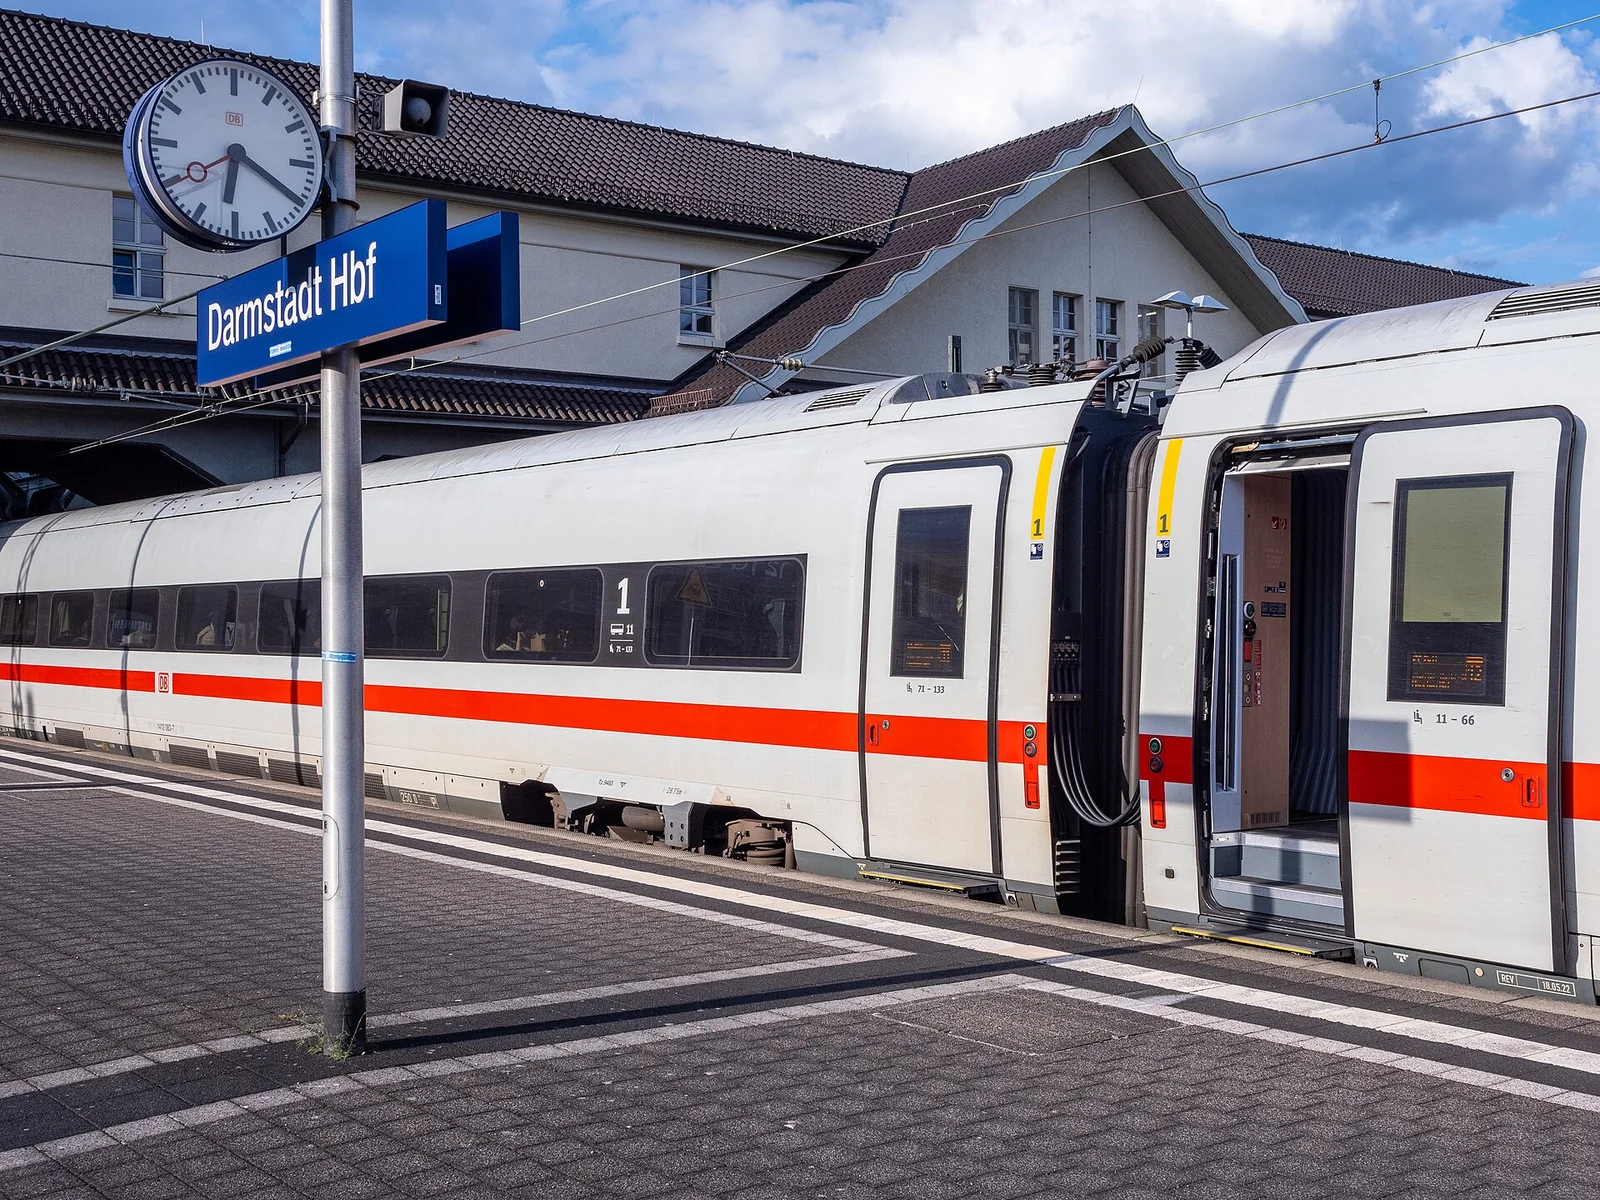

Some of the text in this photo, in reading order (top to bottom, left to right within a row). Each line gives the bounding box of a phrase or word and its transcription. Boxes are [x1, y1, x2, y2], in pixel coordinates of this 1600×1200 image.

[227, 112, 242, 125] DB
[208, 241, 377, 351] Darmstadt Hbf
[1033, 518, 1042, 536] 1
[1160, 514, 1169, 533] 1
[616, 577, 630, 614] 1
[625, 624, 634, 635] 11
[159, 674, 169, 691] DB
[917, 685, 925, 693] 71
[933, 685, 945, 694] 133
[1436, 713, 1447, 724] 11
[1461, 714, 1475, 725] 66
[1501, 973, 1571, 993] REV 18.05.22
